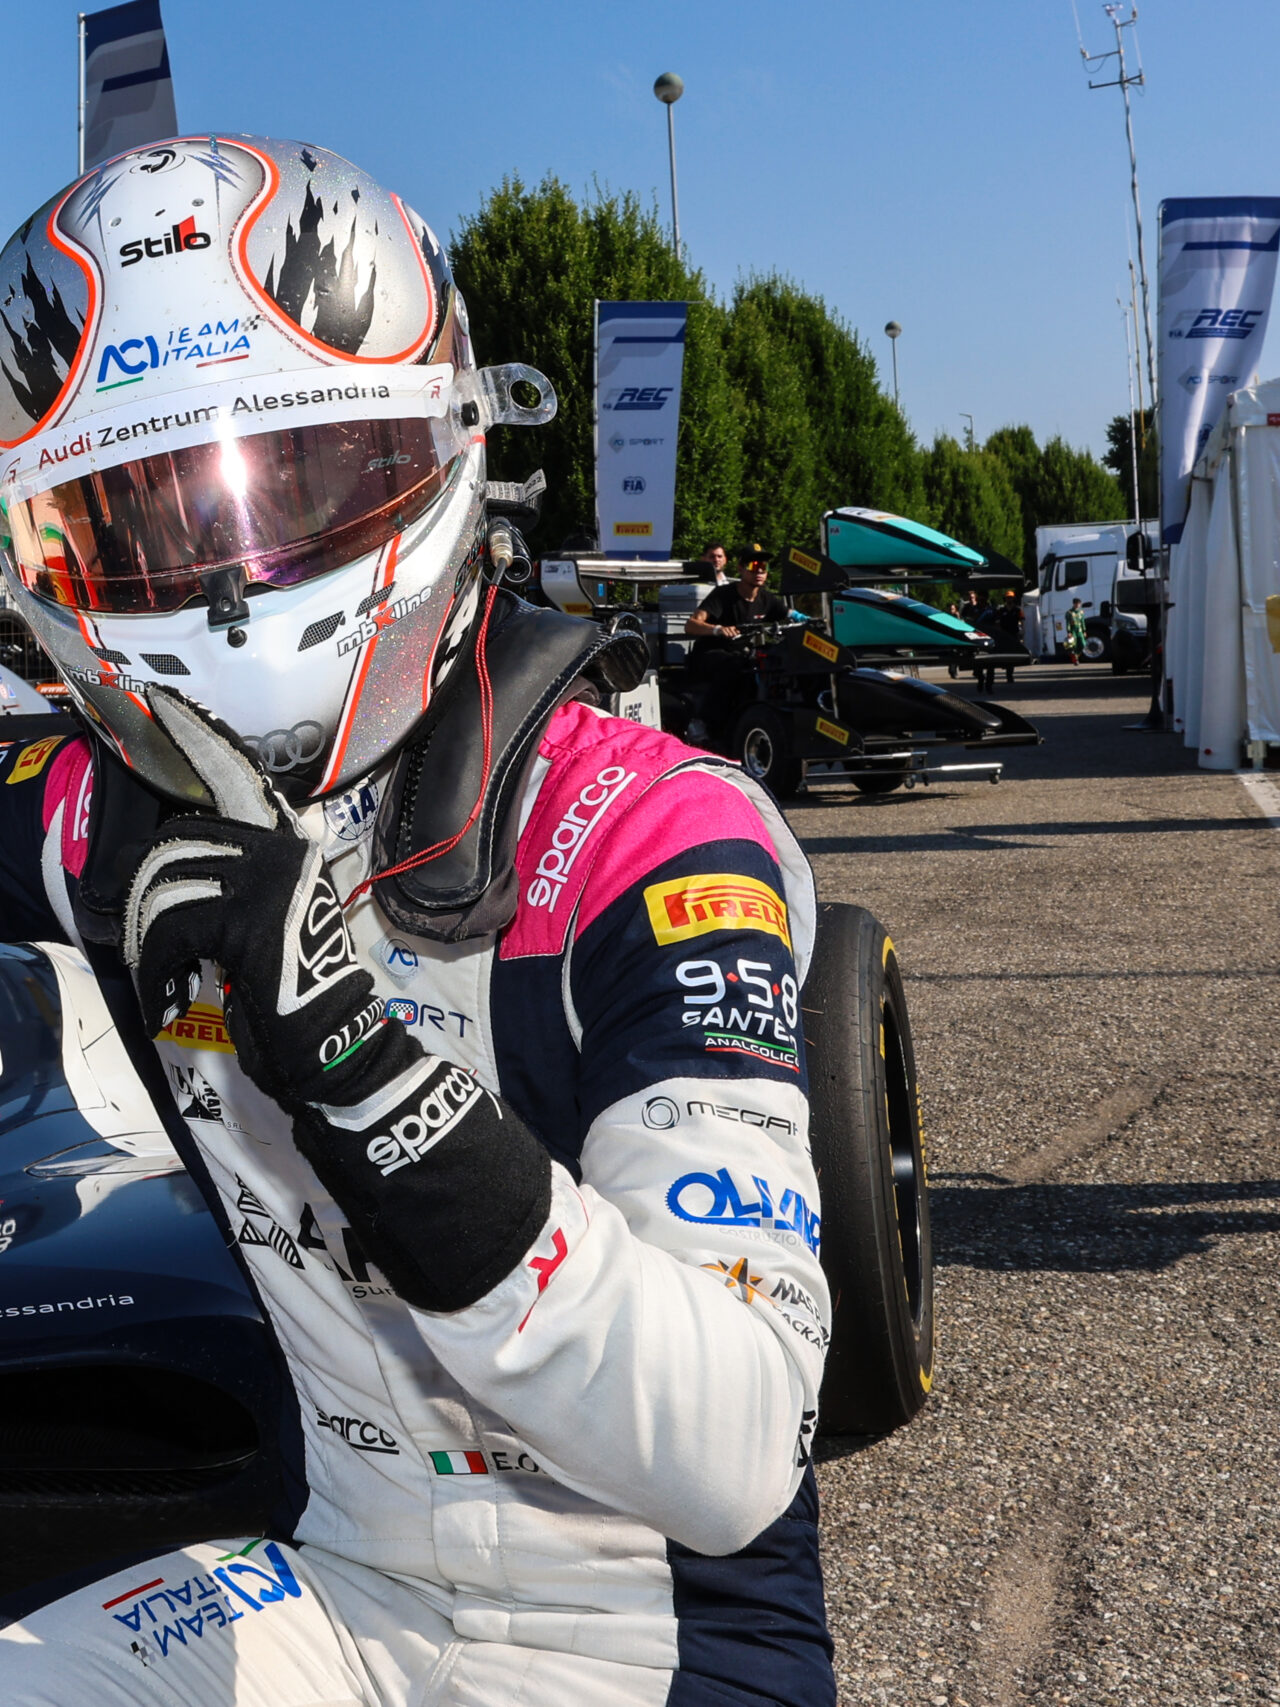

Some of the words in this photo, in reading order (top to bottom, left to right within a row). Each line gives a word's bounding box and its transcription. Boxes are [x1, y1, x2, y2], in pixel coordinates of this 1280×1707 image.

[97, 335, 160, 383] ACI
[163, 335, 251, 365] ITALIA
[168, 319, 239, 345] TEAM
[37, 431, 93, 471] Audi
[97, 404, 219, 448] Zentrum
[230, 382, 391, 417] Alessandria
[527, 765, 637, 913] sparco
[367, 1067, 483, 1177] sparco
[112, 1573, 222, 1632] ITALIA
[152, 1595, 244, 1657] TEAM
